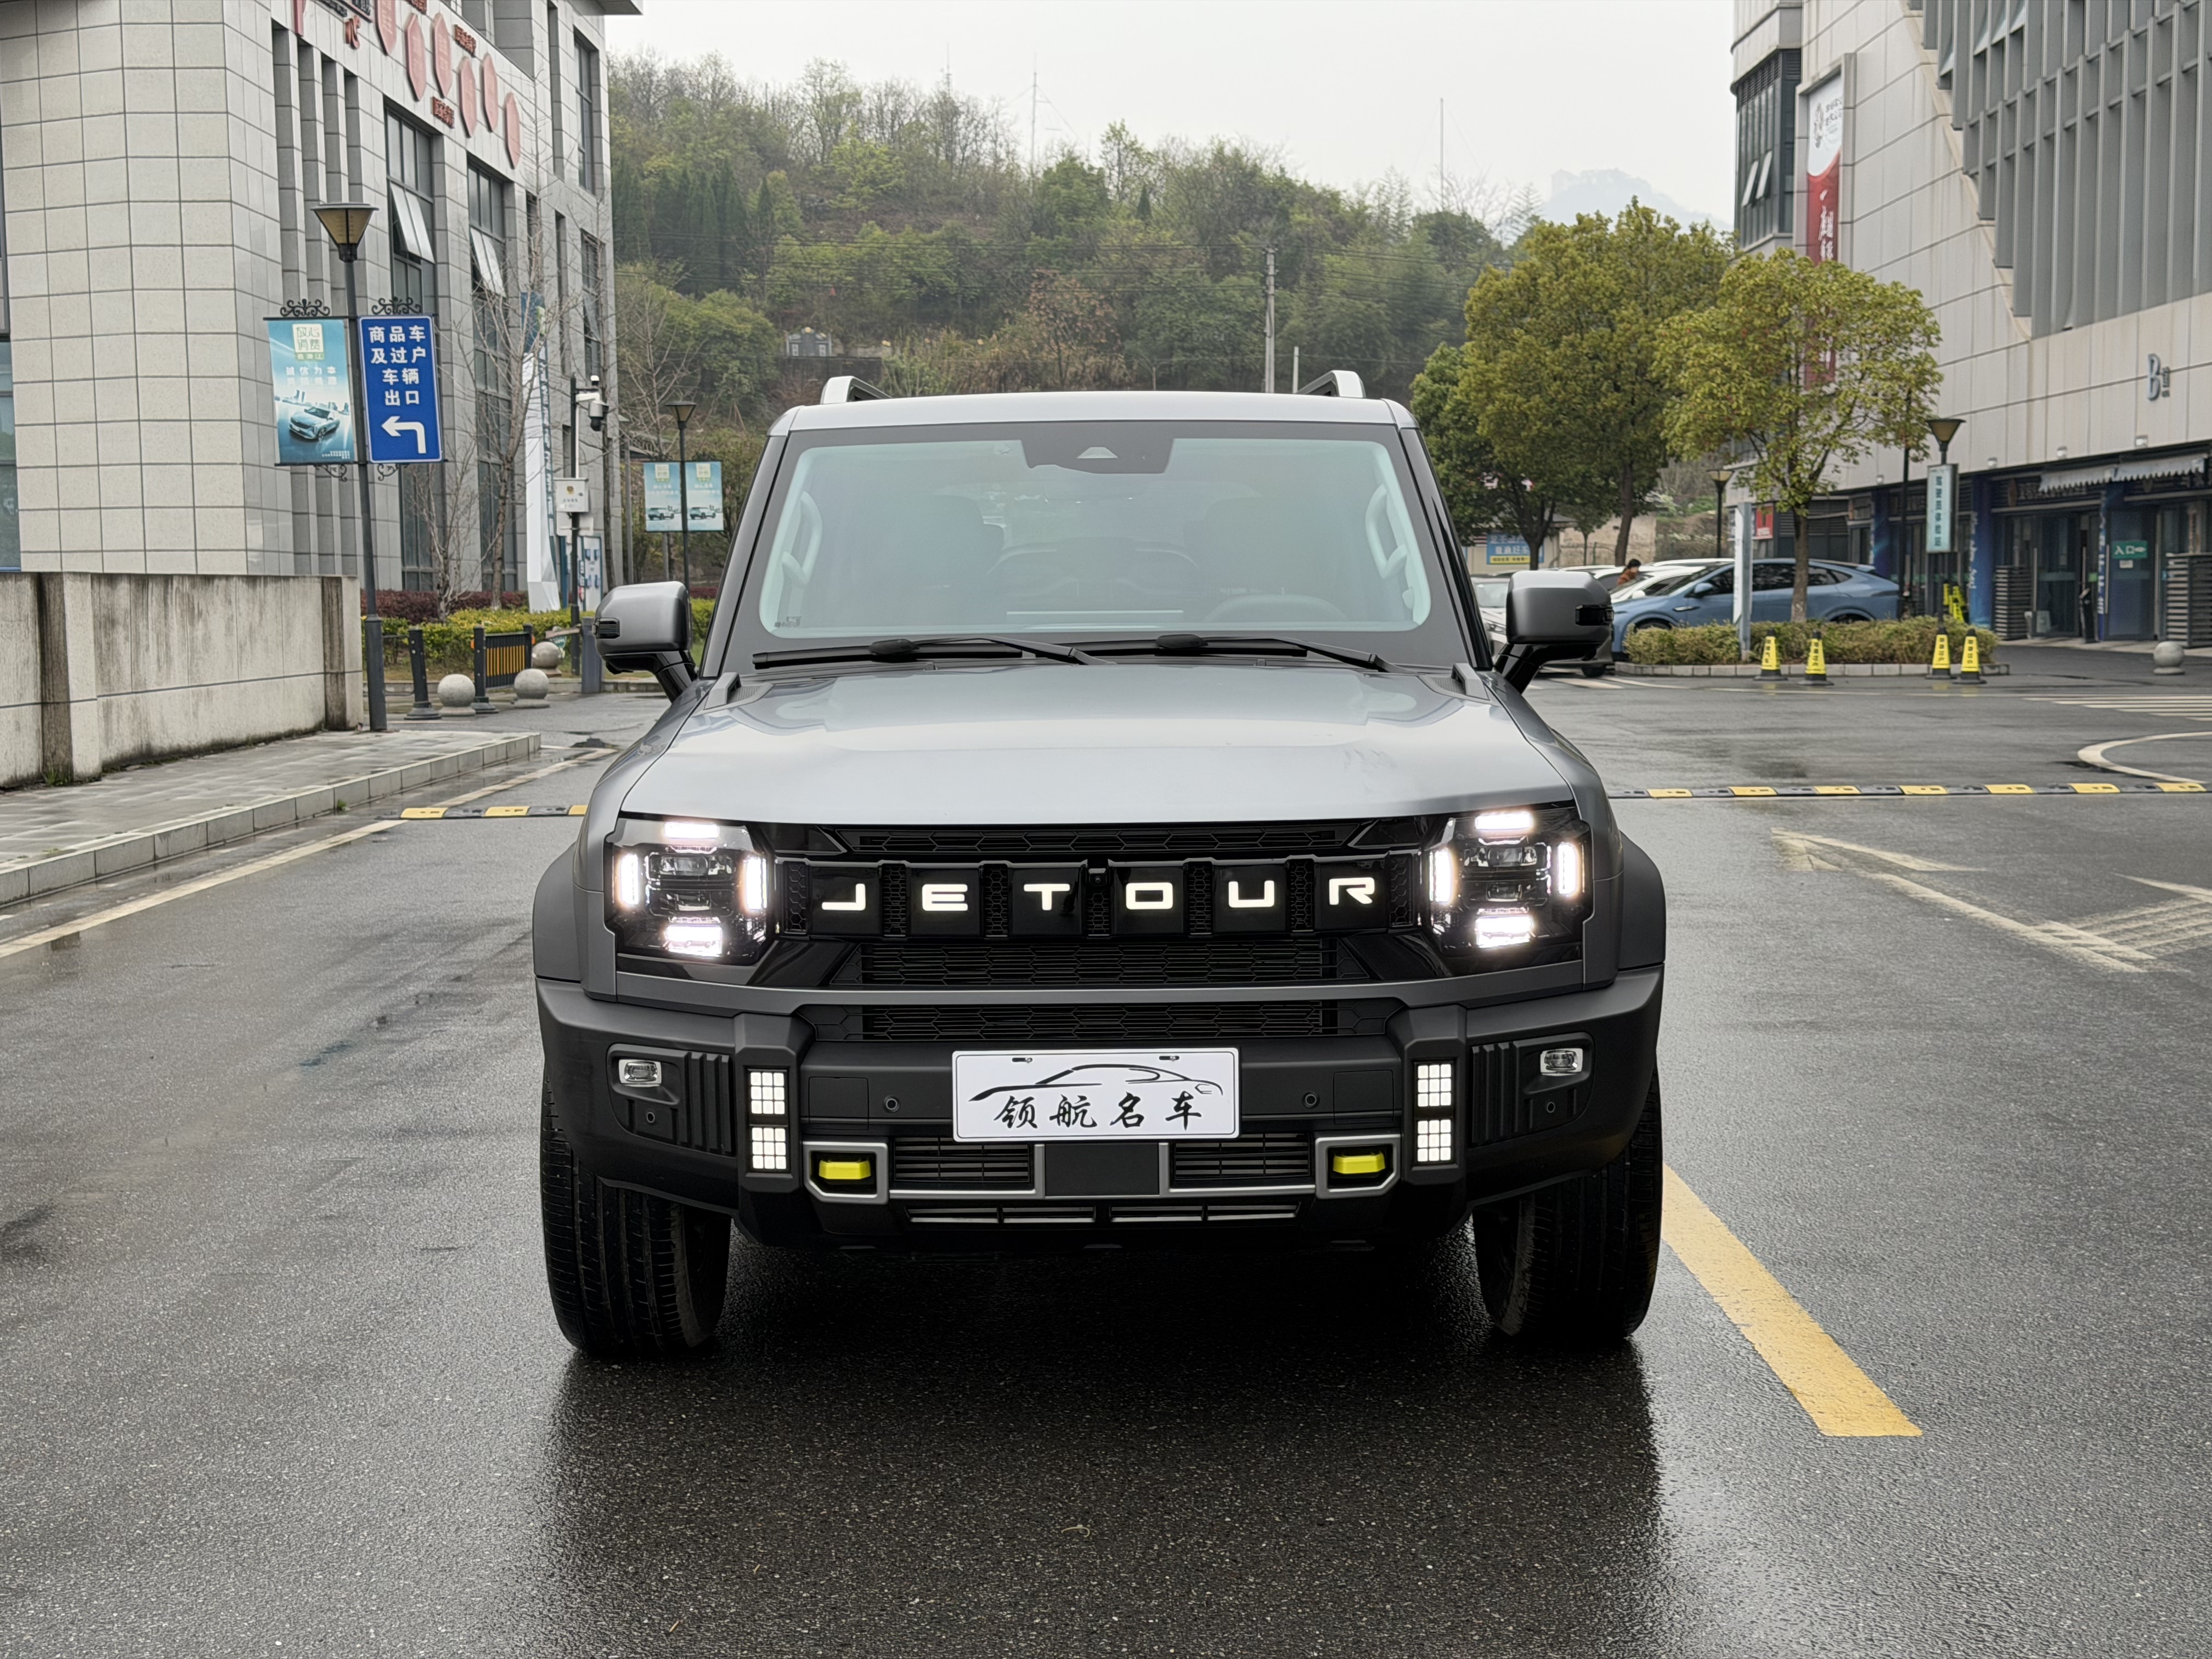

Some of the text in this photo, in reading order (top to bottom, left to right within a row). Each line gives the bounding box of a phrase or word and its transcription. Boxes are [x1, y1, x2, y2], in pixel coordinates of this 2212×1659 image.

[368, 325, 426, 343] 商品车
[370, 346, 426, 364] 及过户
[382, 367, 420, 386] 车辆
[385, 388, 420, 407] 出口
[2114, 545, 2135, 555] 入口
[822, 877, 1376, 912] JETOUR
[994, 1091, 1202, 1131] 领航名车
